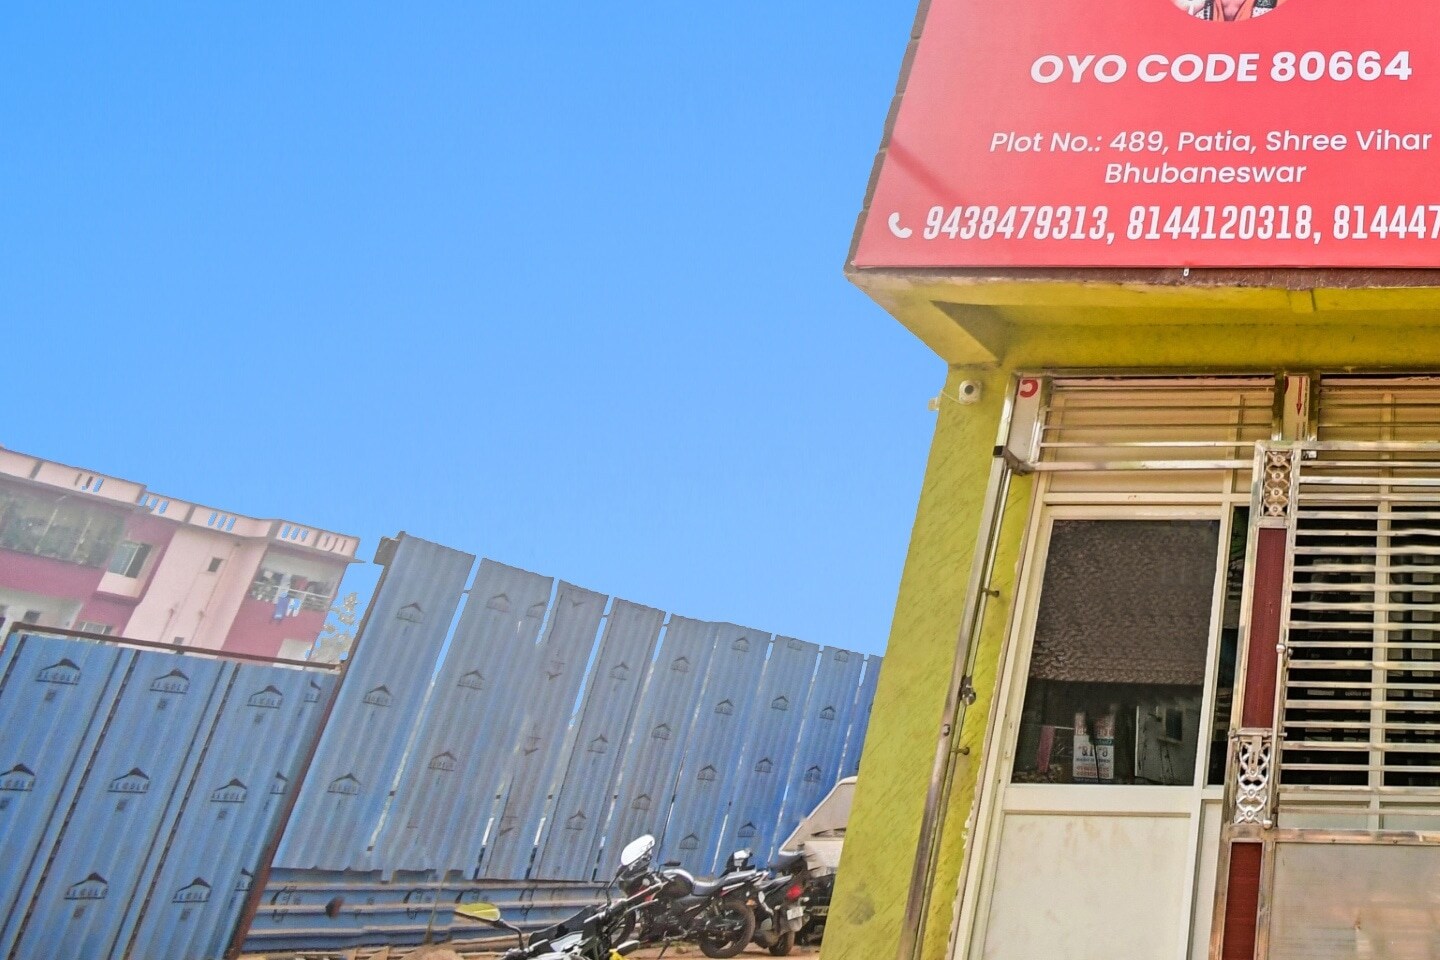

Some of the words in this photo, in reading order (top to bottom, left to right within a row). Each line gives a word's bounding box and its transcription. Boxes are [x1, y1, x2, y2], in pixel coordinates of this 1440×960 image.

[1030, 54, 1127, 84] OYO
[1137, 53, 1260, 83] CODE
[1270, 50, 1413, 82] 80664
[989, 131, 1044, 153] Plot
[1049, 132, 1102, 152] No.:
[1109, 130, 1169, 155] 489,
[1177, 129, 1257, 155] Patia,
[1265, 130, 1348, 151] Shree
[1356, 128, 1433, 151] Vihar
[1104, 162, 1307, 184] Bhubaneswar
[923, 205, 1115, 245] 9438479313,
[1126, 204, 1322, 245] 8144120318,
